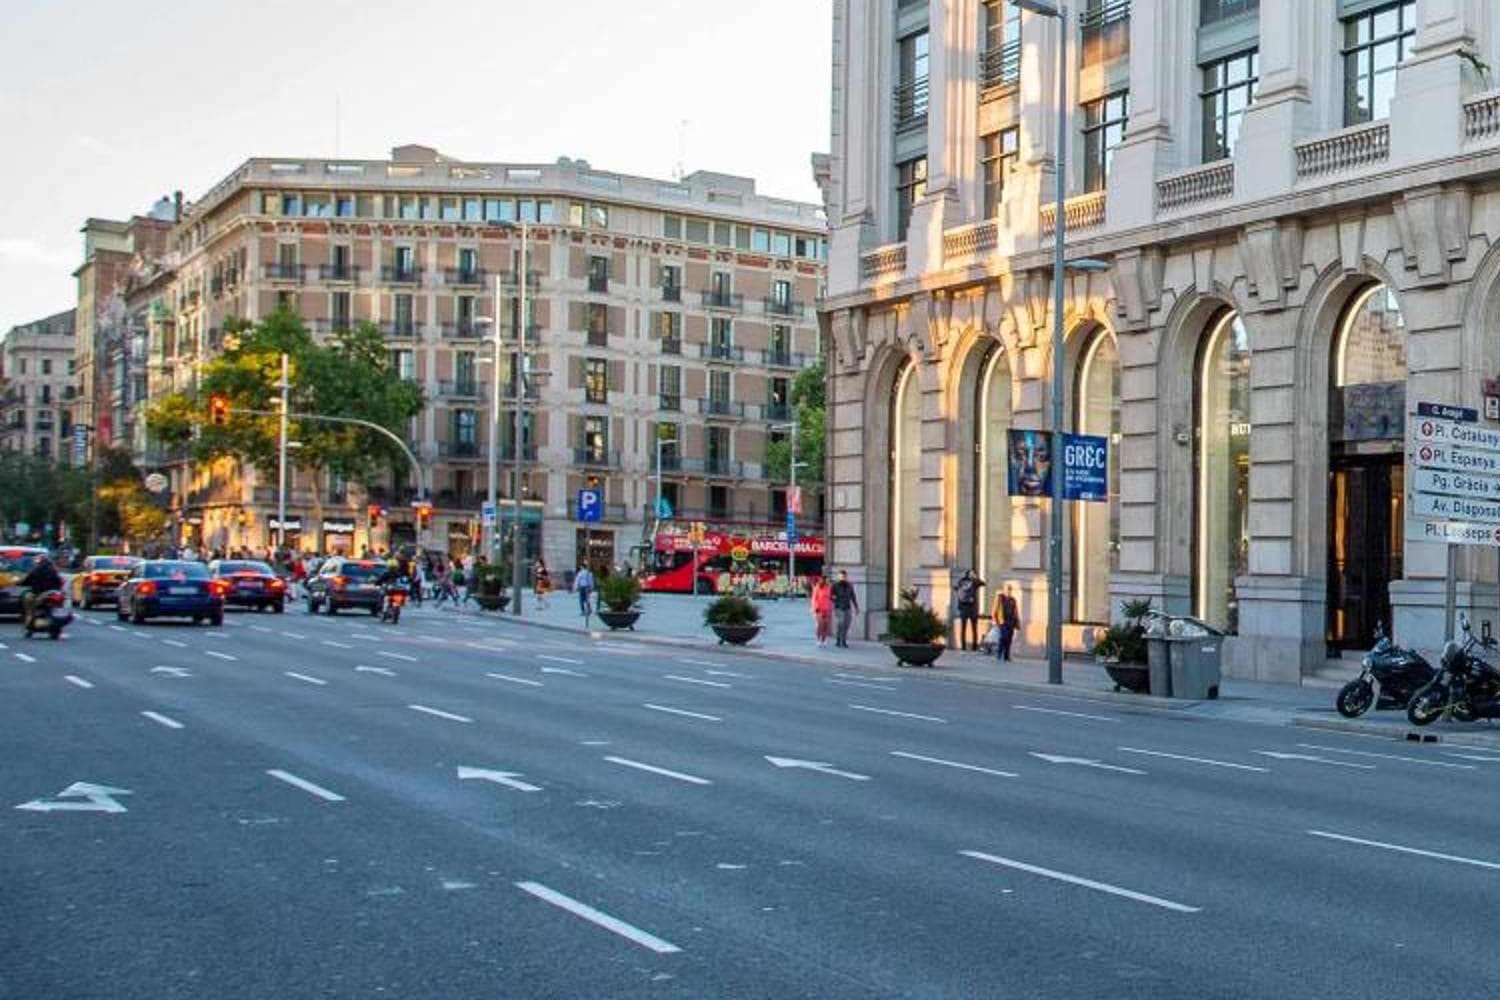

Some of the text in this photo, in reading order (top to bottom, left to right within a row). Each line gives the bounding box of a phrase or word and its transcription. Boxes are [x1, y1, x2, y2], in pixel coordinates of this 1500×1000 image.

[1451, 451, 1496, 470] Espanya
[1432, 474, 1489, 492] Pg. Gràcia
[581, 491, 597, 509] P
[1432, 499, 1500, 518] Av. Diagonal
[1426, 523, 1440, 536] Pl.
